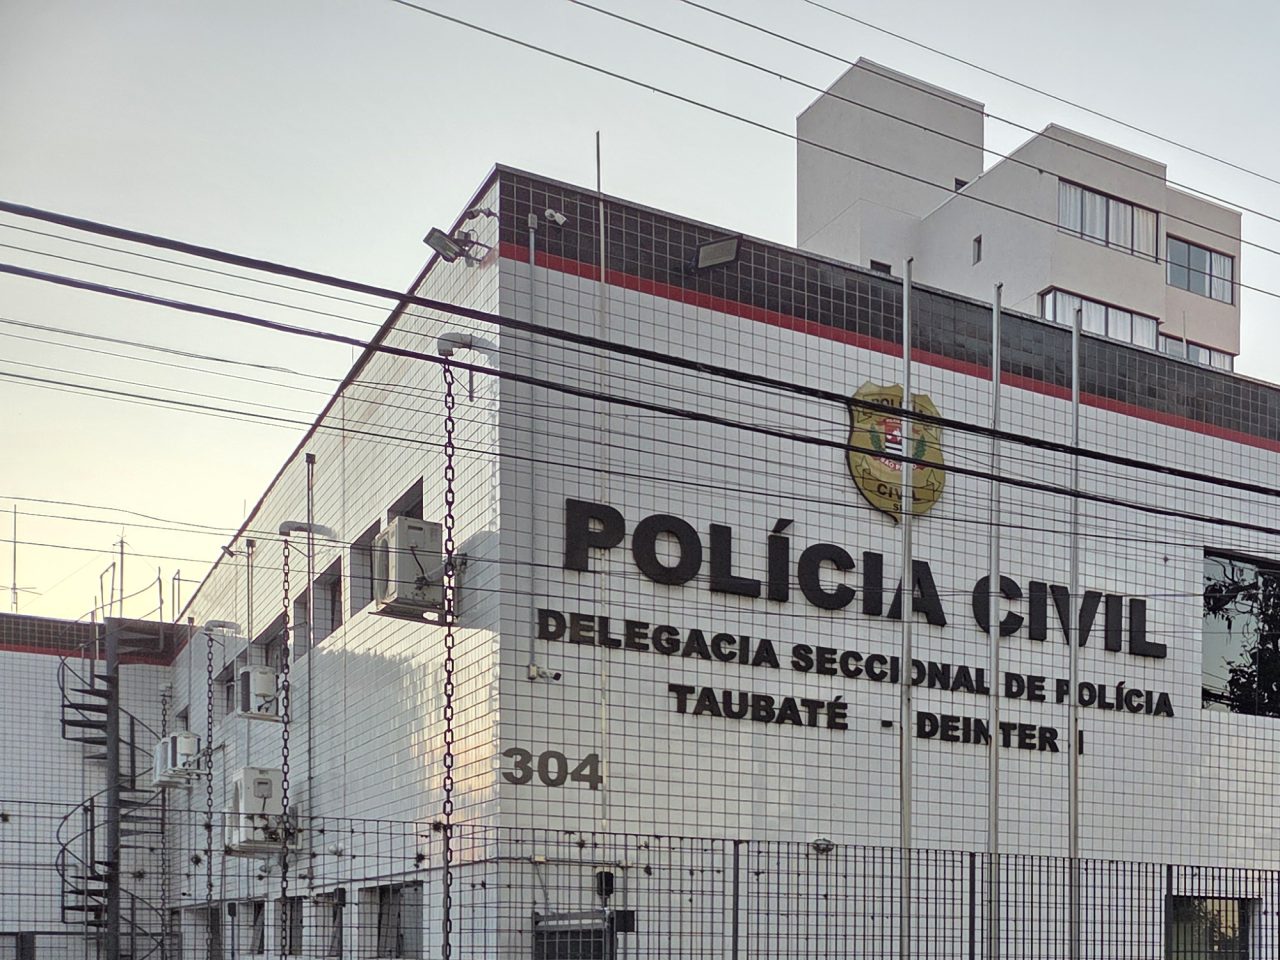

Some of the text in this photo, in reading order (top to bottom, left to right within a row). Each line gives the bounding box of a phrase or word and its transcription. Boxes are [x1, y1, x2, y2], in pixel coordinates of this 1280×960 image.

[877, 483, 920, 501] CIVL
[564, 498, 1167, 658] POLÍCIA CIVIL
[538, 609, 1174, 717] DELEGACIA SECCIONAL DE POLÍCIA
[669, 684, 848, 729] TAUBATÉ
[917, 711, 1059, 752] DEINTER
[502, 748, 603, 791] 304
